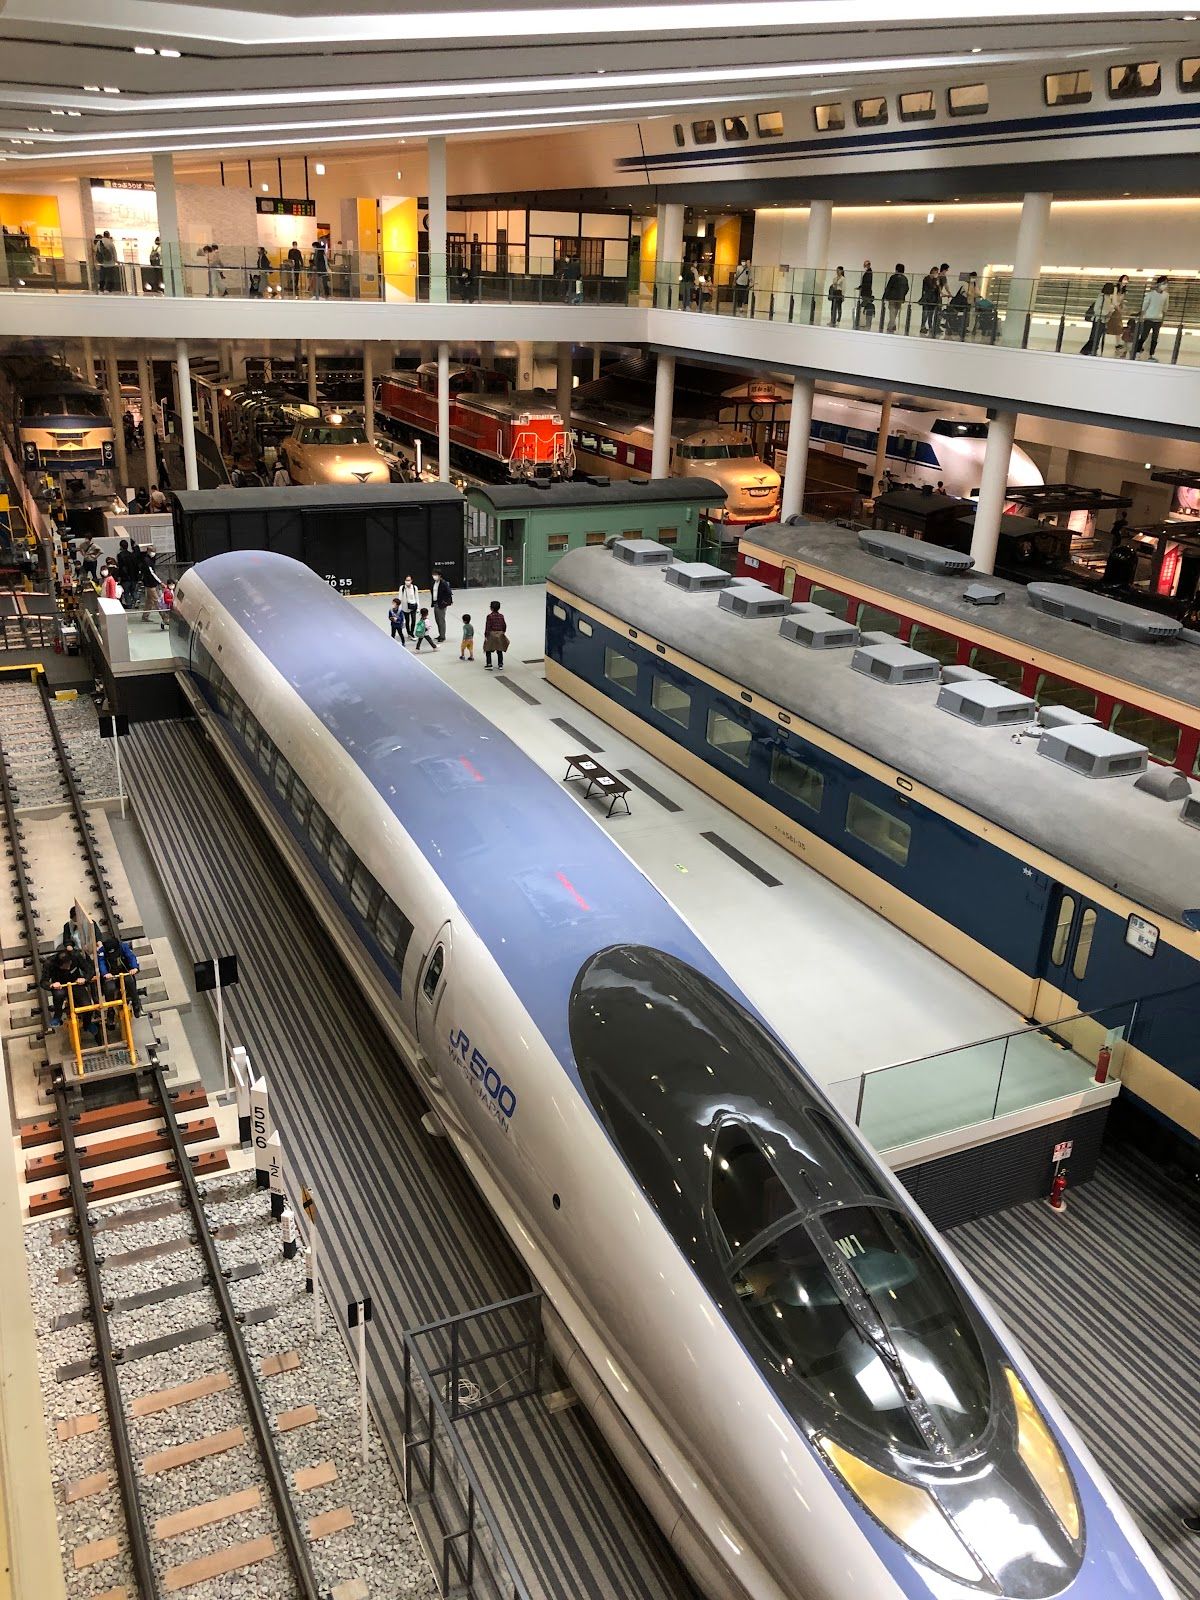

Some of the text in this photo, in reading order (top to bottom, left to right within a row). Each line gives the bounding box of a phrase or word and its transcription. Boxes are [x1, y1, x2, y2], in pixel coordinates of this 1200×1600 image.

[448, 1045, 510, 1133] WEST JAPAN
[254, 1106, 267, 1149] 556
[834, 1234, 866, 1259] W1
